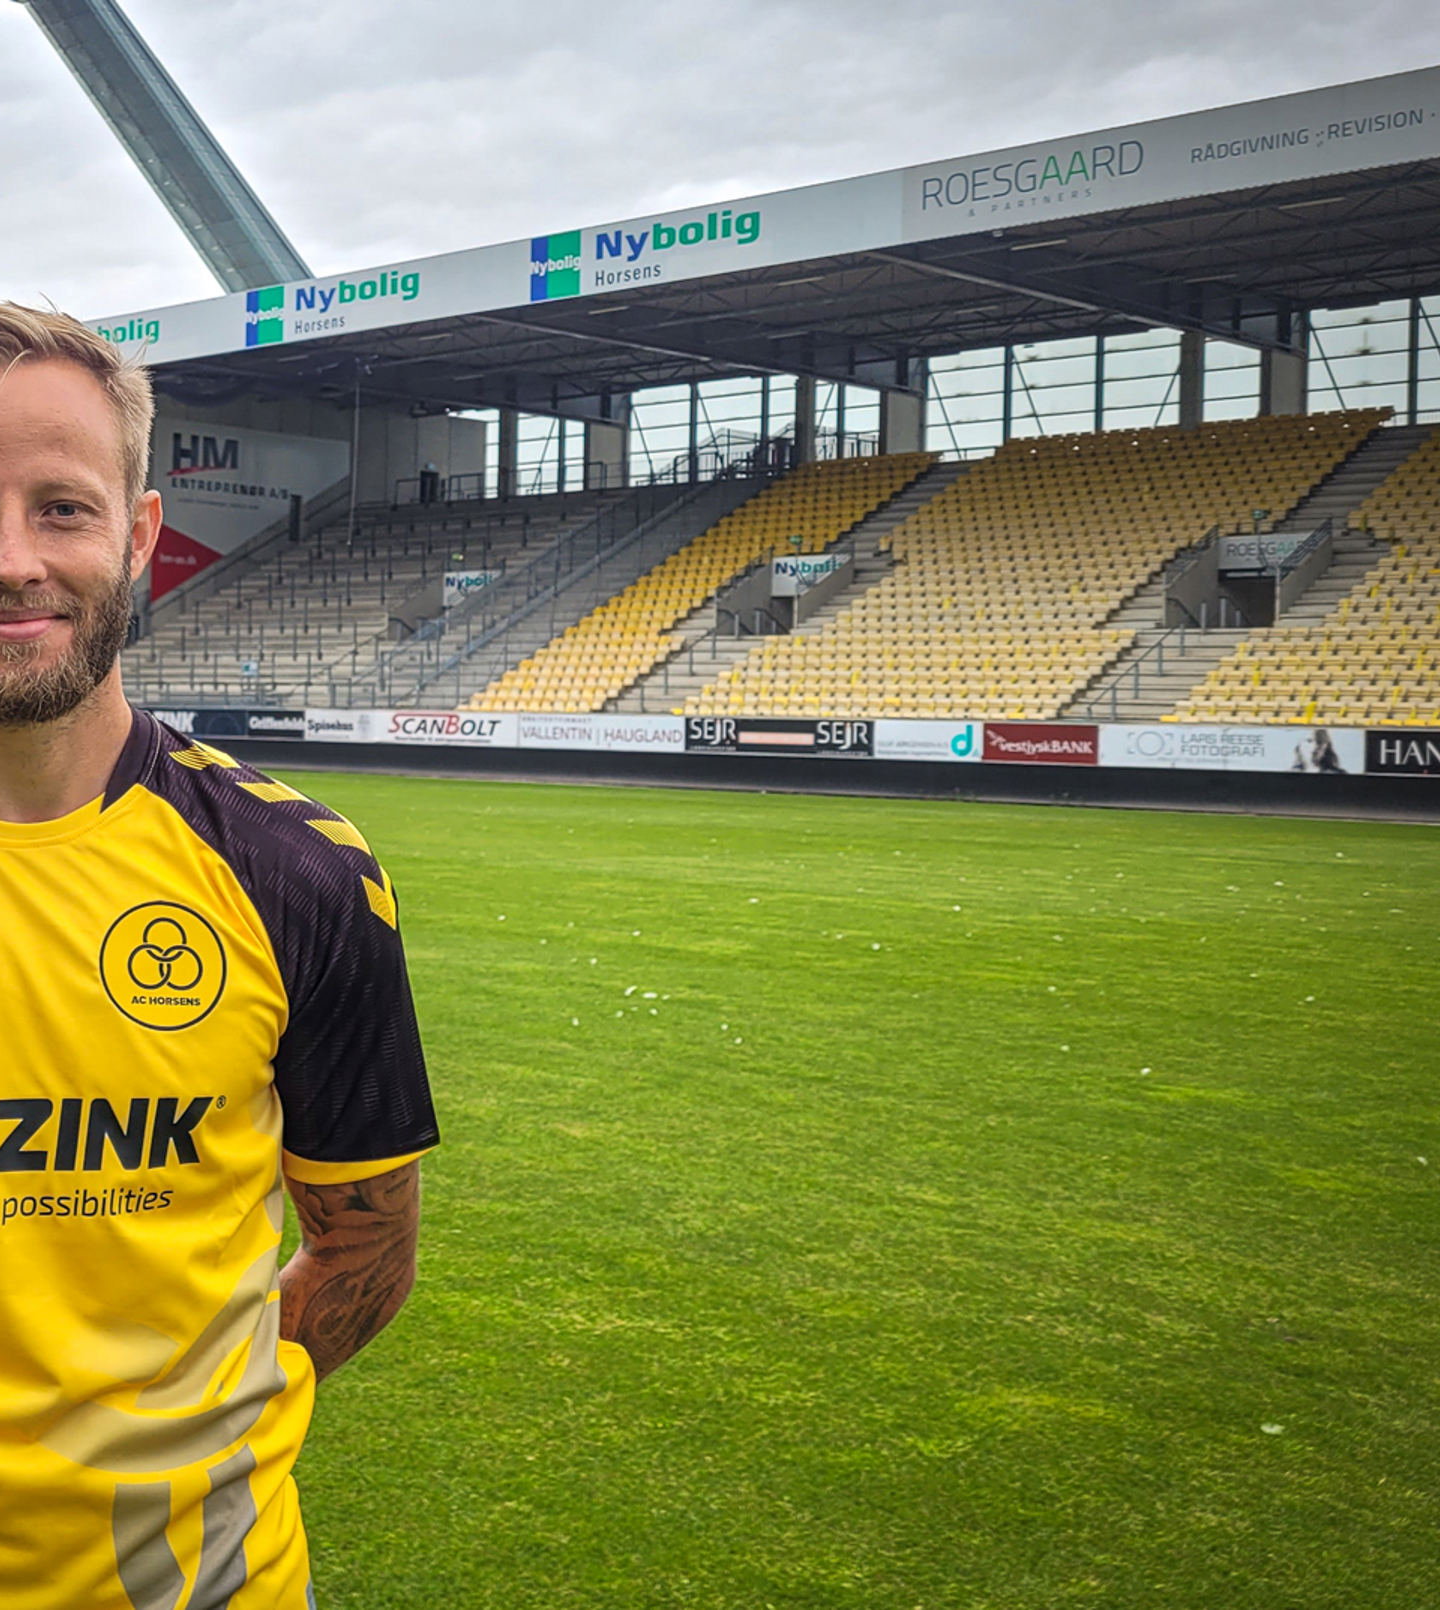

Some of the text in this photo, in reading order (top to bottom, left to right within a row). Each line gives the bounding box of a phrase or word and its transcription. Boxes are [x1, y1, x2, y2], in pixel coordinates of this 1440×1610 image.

[1191, 108, 1424, 163] RÅDGIVNING REVISION
[922, 140, 1144, 210] ROESGAARD
[991, 189, 1092, 212] PARTNERS
[596, 210, 760, 262] Nybolig
[530, 255, 581, 277] Nybolig
[595, 264, 661, 287] Horsens
[296, 270, 420, 313] Nybolig
[294, 316, 345, 334] Horsens
[171, 432, 239, 471] HM
[522, 727, 683, 743] VALLENTIN HAUGLAND
[1181, 745, 1264, 757] FOTOGRAFI
[132, 996, 201, 1006] AC HORSENS
[2, 1188, 174, 1225] possibilities
